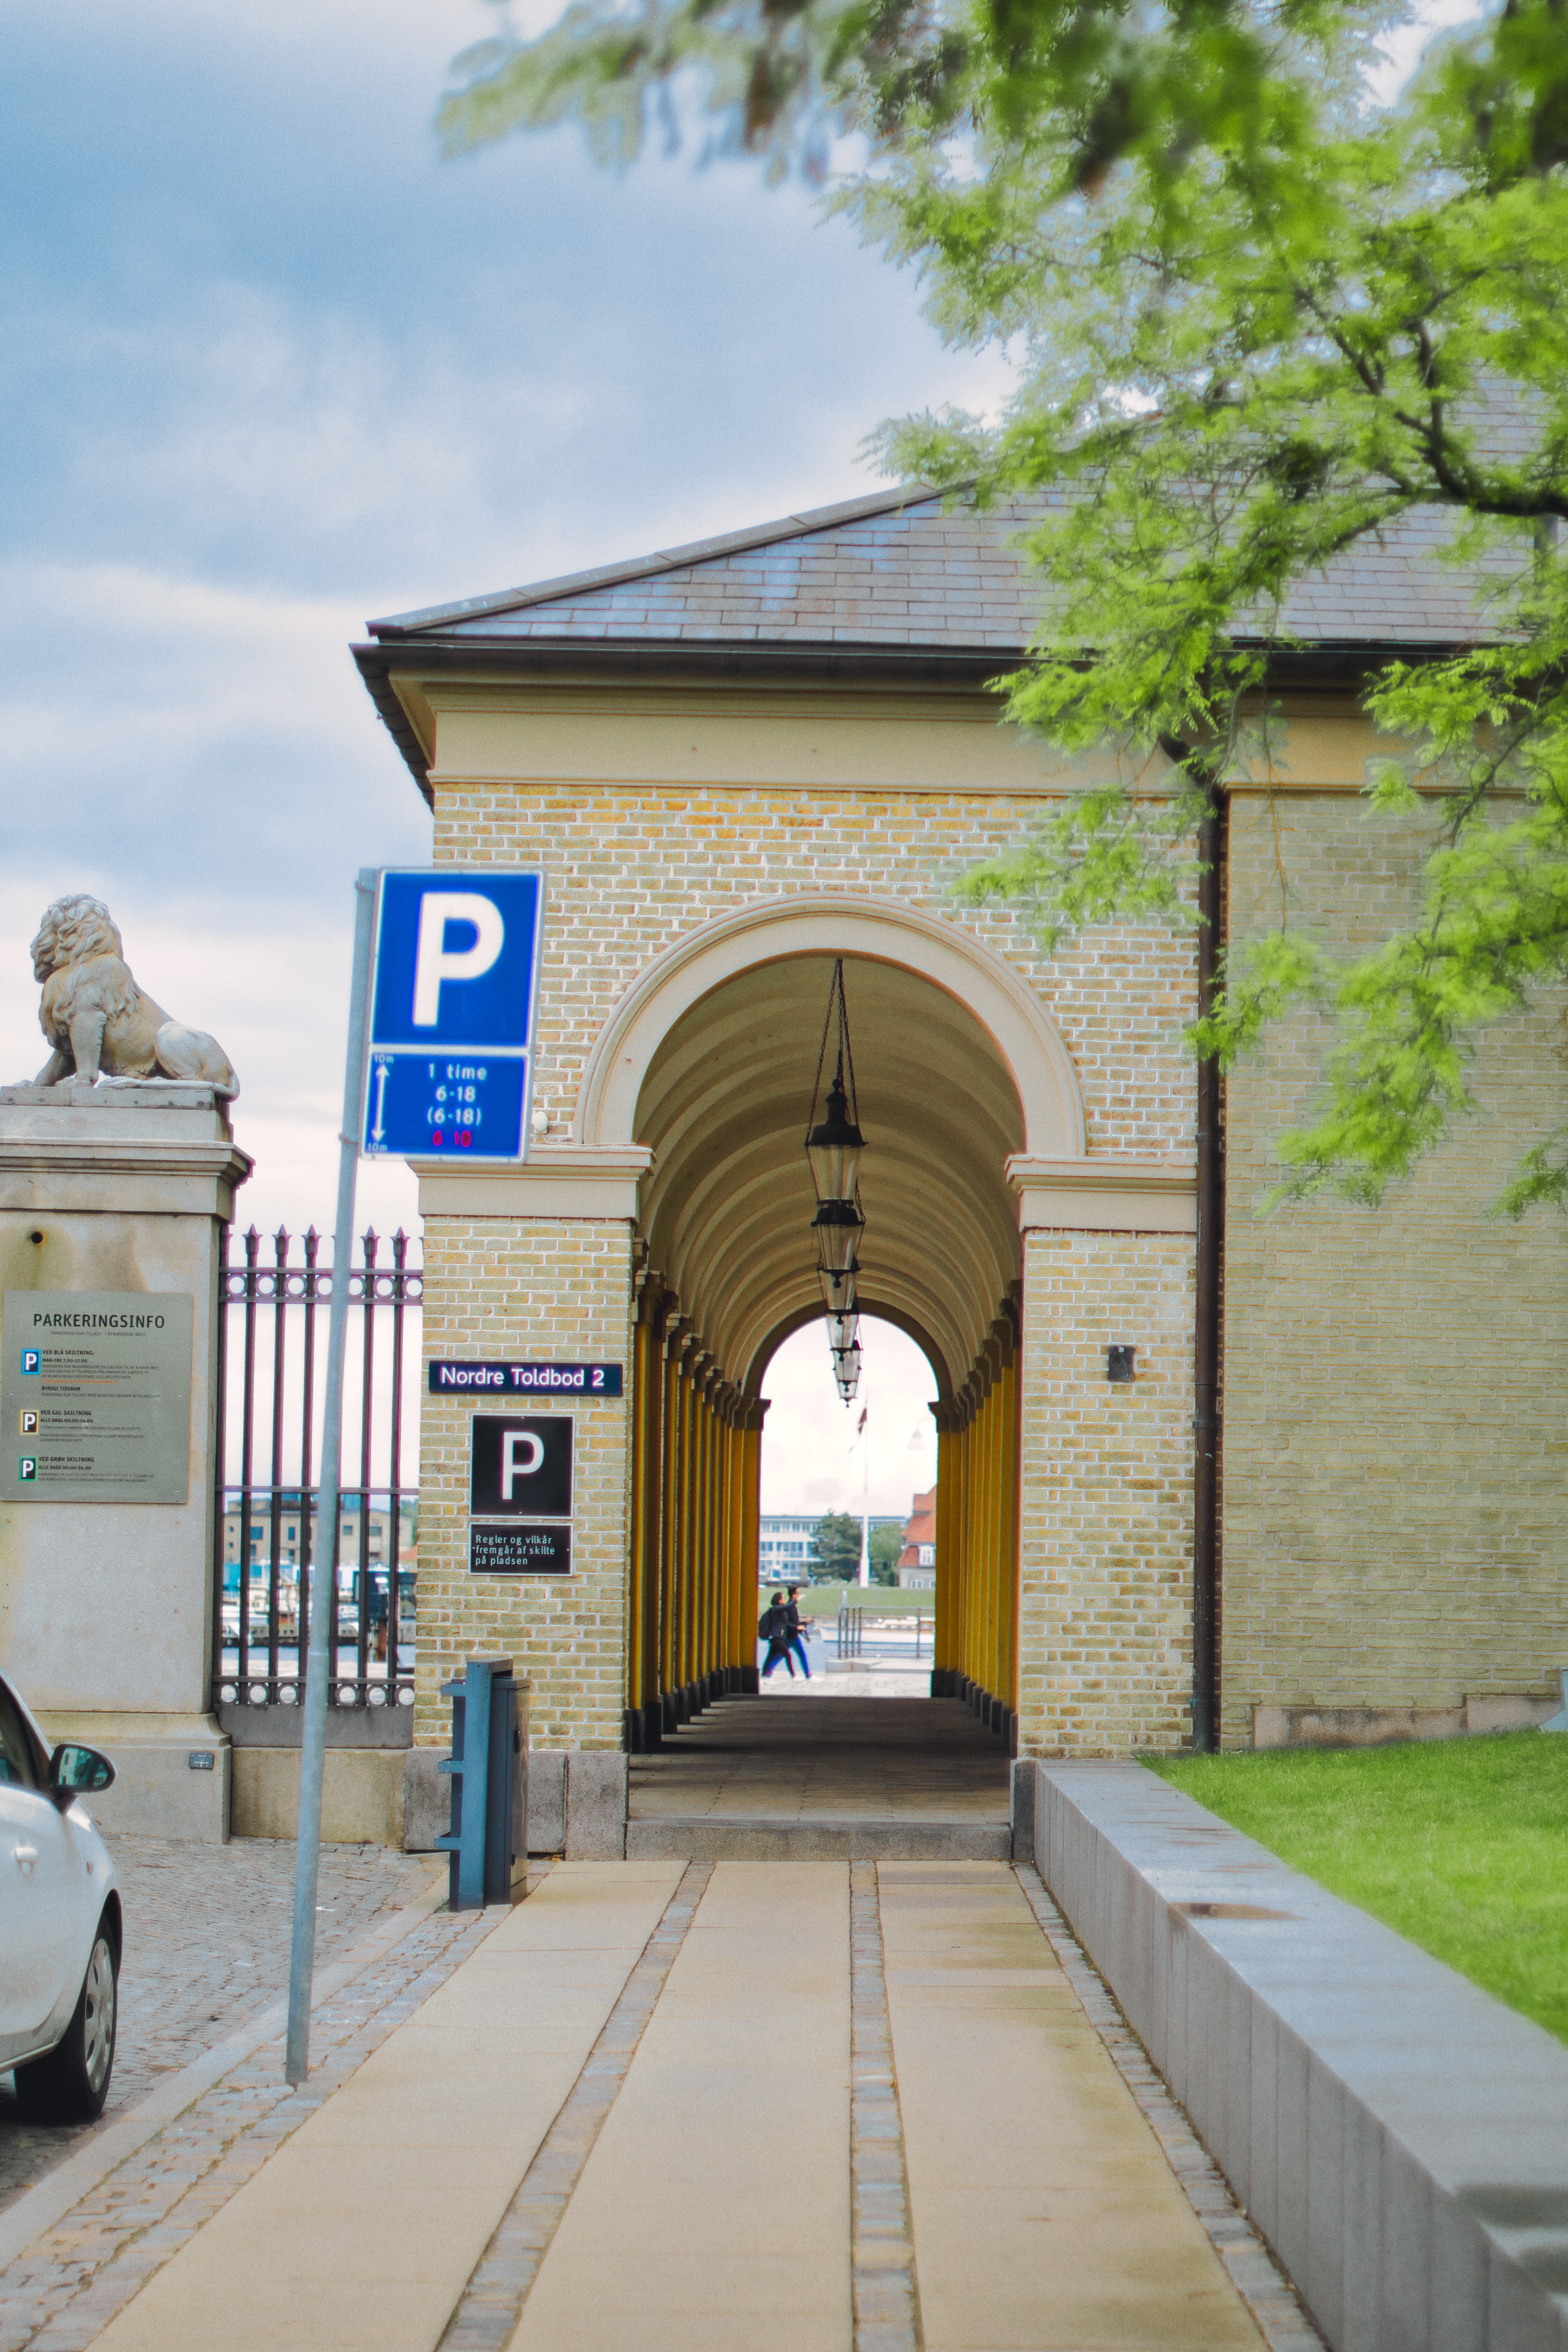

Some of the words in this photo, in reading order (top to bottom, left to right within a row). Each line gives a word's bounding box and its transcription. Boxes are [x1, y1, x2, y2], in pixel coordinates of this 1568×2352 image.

[413, 892, 503, 1026] P
[429, 1063, 435, 1079] 1
[447, 1063, 486, 1080] time
[436, 1085, 475, 1102] 6-18
[427, 1105, 482, 1126] (6-18)
[33, 1313, 165, 1328] PARKERINGSINFO
[25, 1354, 37, 1370] P
[442, 1367, 504, 1385] Nordre
[511, 1368, 584, 1386] Toldbod
[593, 1370, 605, 1386] 2
[24, 1414, 36, 1431] P
[23, 1461, 34, 1477] P
[502, 1432, 544, 1500] P
[476, 1535, 507, 1545] Regler
[510, 1537, 522, 1545] og
[525, 1535, 552, 1544] vilkår
[476, 1545, 514, 1555] fremgår
[517, 1546, 527, 1554] af
[529, 1546, 555, 1554] skilte
[475, 1555, 486, 1566] på
[490, 1556, 528, 1566] pladsen
